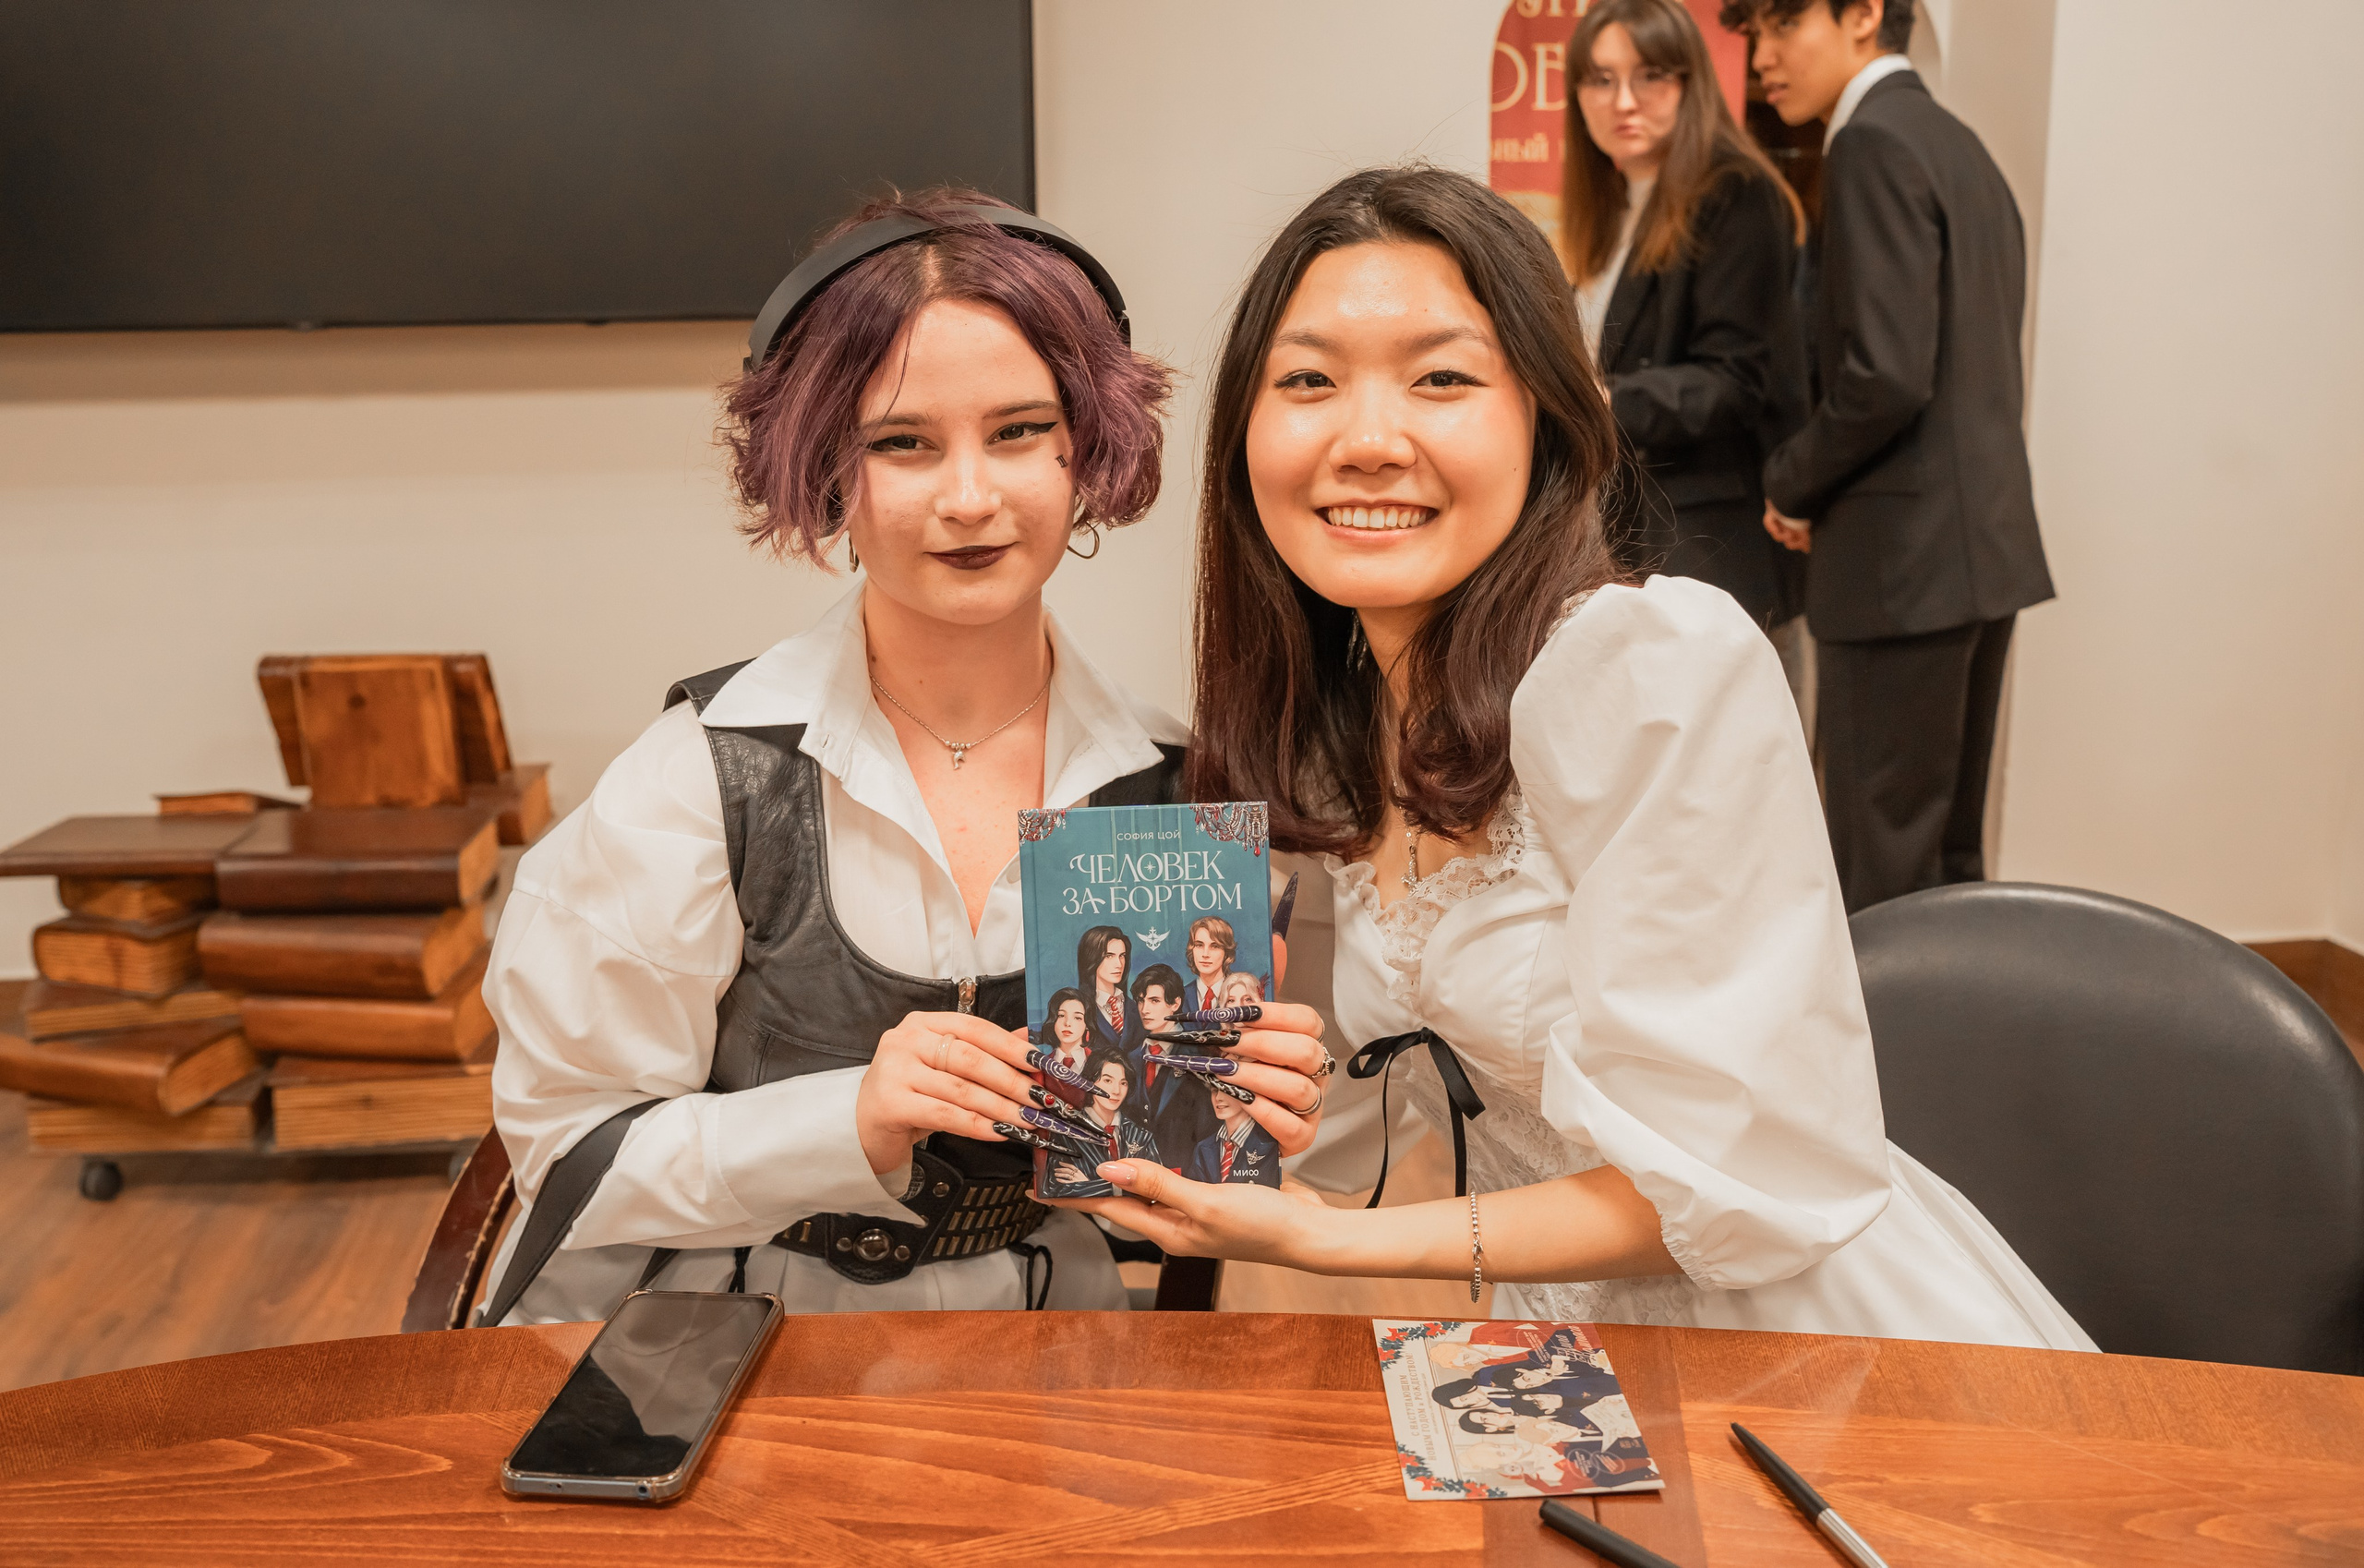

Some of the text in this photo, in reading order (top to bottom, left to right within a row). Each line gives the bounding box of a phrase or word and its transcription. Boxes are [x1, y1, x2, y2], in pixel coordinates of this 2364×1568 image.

[1116, 829, 1181, 841] СОФИЯ ЦОЙ
[1069, 850, 1225, 884] ЧЕЛОВЕК
[1062, 883, 1243, 915] ЗА БОРТОМ
